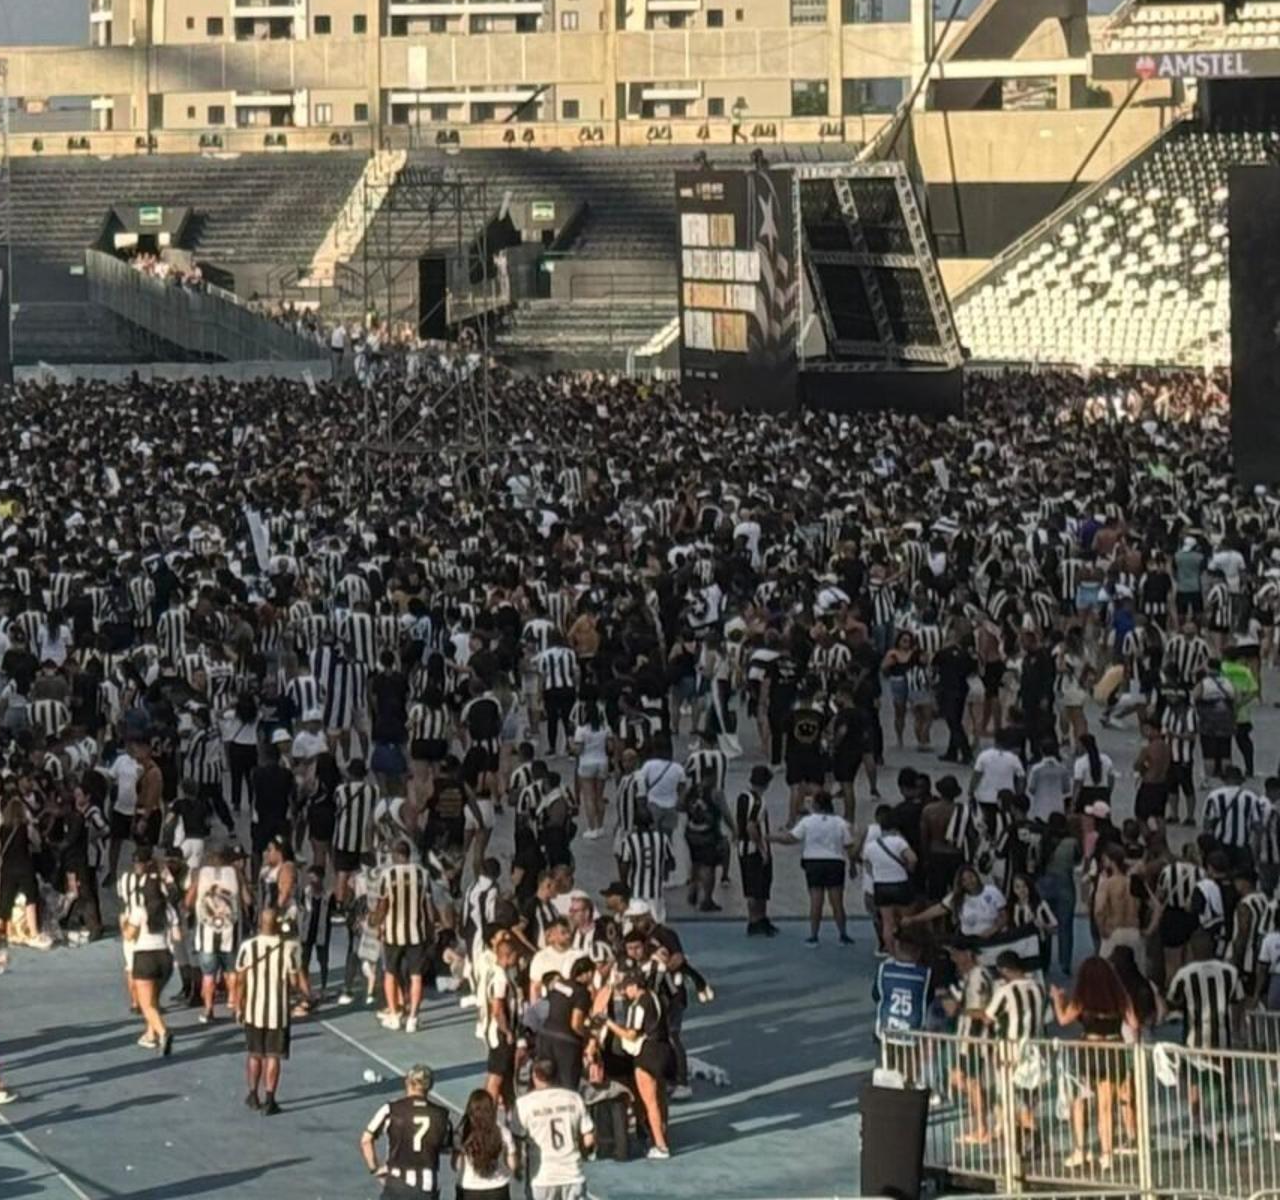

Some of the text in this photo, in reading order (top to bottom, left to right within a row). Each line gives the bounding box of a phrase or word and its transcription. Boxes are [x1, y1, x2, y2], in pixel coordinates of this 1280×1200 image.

[1158, 53, 1249, 76] AMSTEL
[890, 993, 911, 1017] 25
[411, 1116, 428, 1153] 7
[549, 1117, 566, 1151] 6
